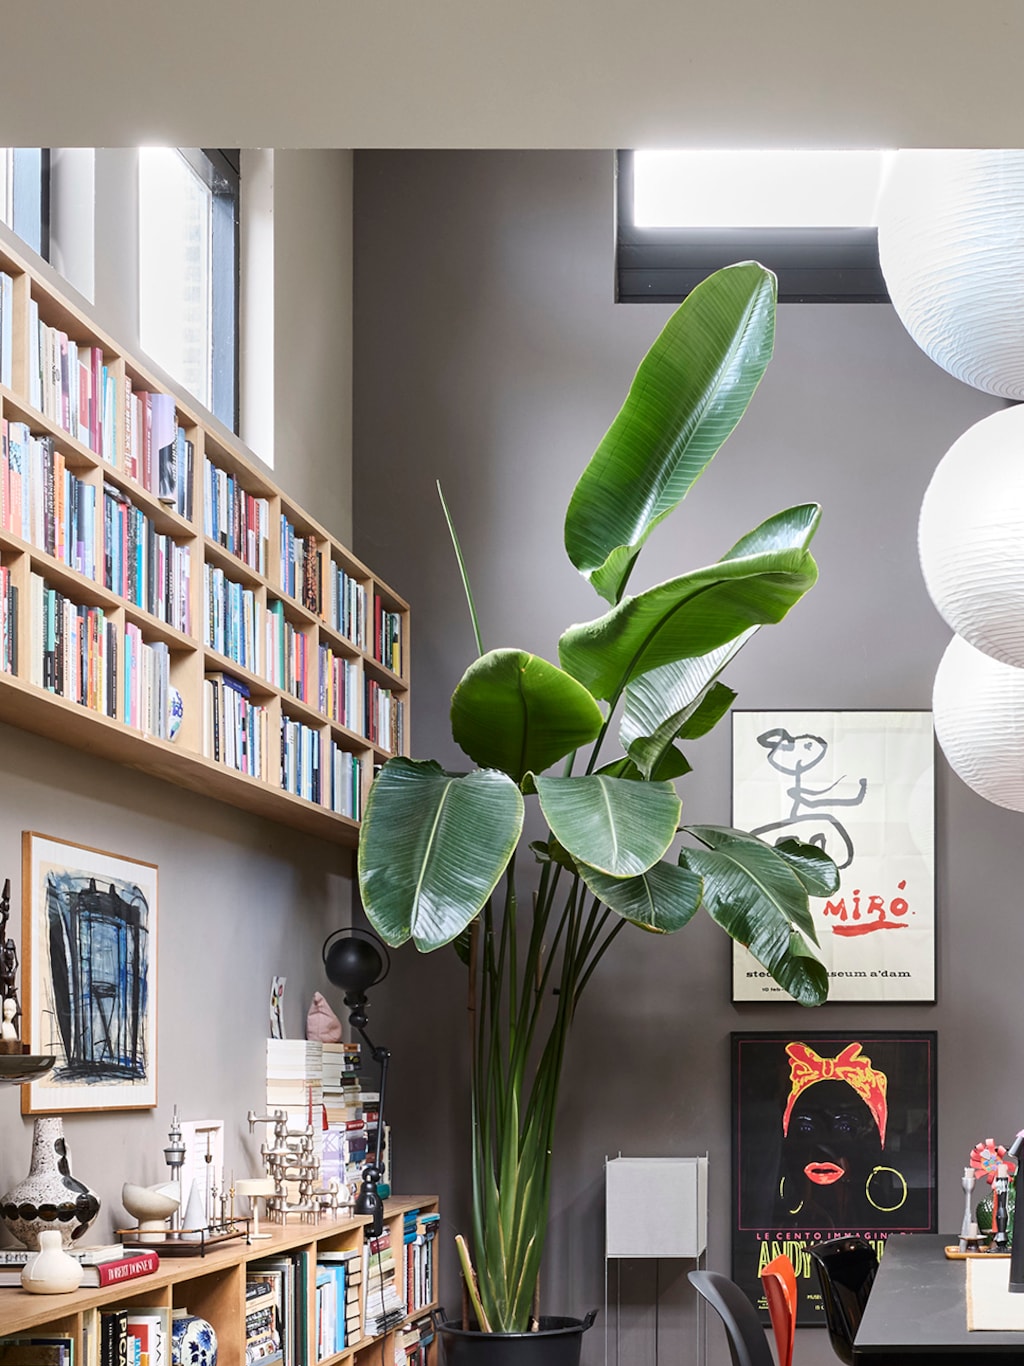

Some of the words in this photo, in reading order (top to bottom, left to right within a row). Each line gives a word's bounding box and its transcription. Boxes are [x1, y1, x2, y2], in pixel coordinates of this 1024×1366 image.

[870, 970, 912, 978] a'dam
[756, 1232, 770, 1240] LE
[776, 1232, 822, 1240] CENTO
